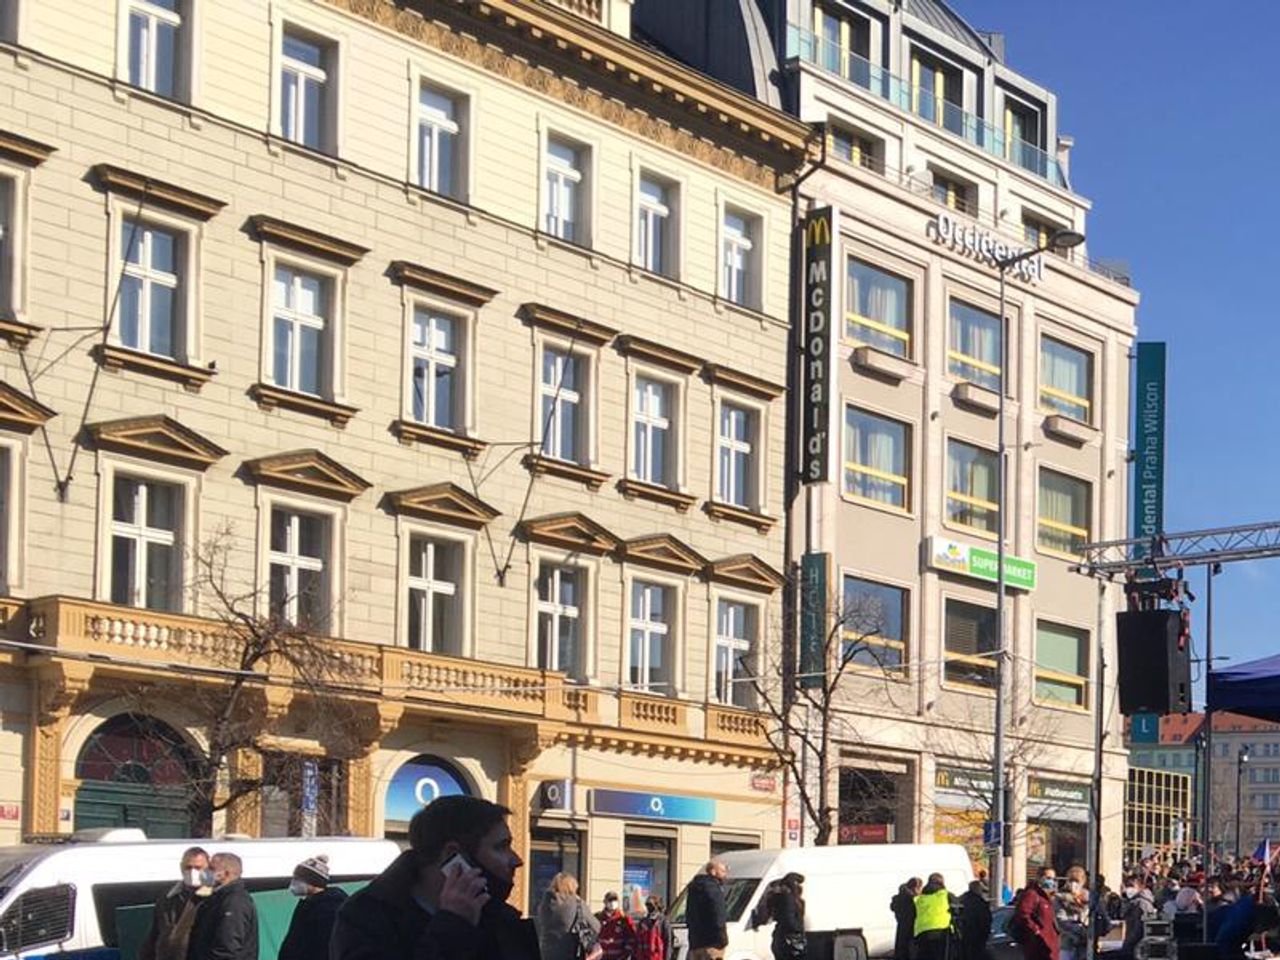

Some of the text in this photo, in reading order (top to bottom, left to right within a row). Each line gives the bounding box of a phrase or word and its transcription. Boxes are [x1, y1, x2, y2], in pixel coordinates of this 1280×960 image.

[808, 260, 827, 479] McDonald's
[1143, 382, 1159, 433] Wilson
[1143, 436, 1158, 479] Praha
